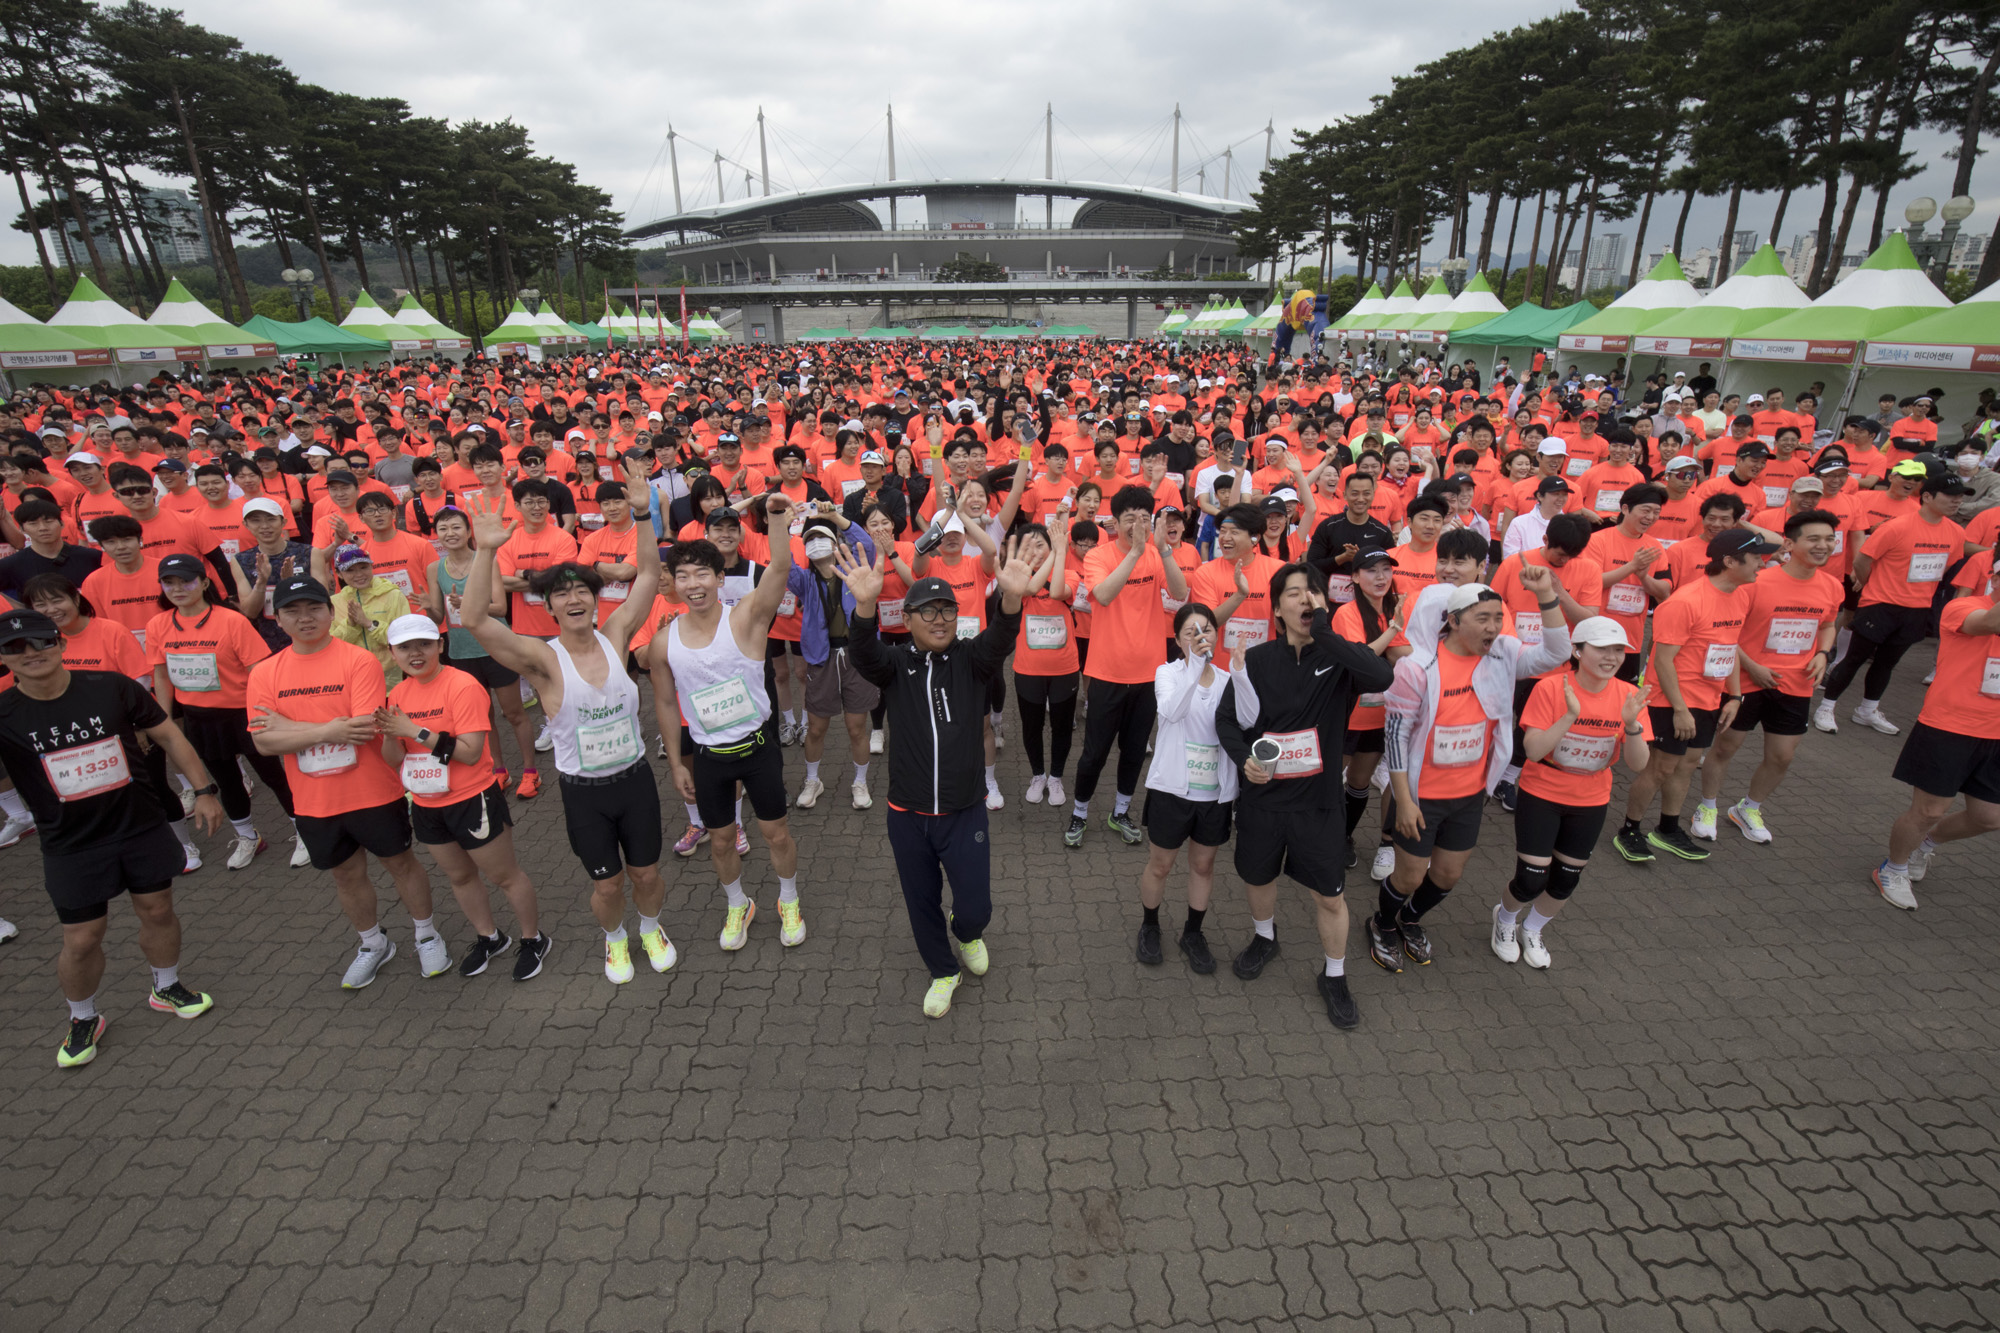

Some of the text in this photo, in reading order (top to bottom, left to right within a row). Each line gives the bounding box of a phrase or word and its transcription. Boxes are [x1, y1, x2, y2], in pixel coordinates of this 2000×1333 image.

[10, 354, 68, 364] 진행본부/도착기념품
[1914, 350, 1954, 362] 미디어센터
[112, 596, 144, 606] BURNING
[165, 640, 197, 651] BURNING
[278, 687, 320, 698] BURNING
[323, 684, 344, 692] RUN
[712, 694, 744, 712] 7270
[592, 704, 624, 720] DENVER
[29, 716, 102, 742] TEAM
[1603, 720, 1622, 728] RUN
[33, 726, 105, 752] HYROX
[597, 734, 630, 752] 7116
[1451, 737, 1481, 750] 1520
[50, 752, 79, 762] BURNING
[81, 749, 95, 757] RUN
[310, 743, 348, 756] 1172
[1279, 747, 1313, 760] 2362
[1571, 748, 1609, 759] 3136
[59, 756, 119, 778] M 1339
[1187, 760, 1218, 771] 8430
[413, 768, 442, 779] 3088
